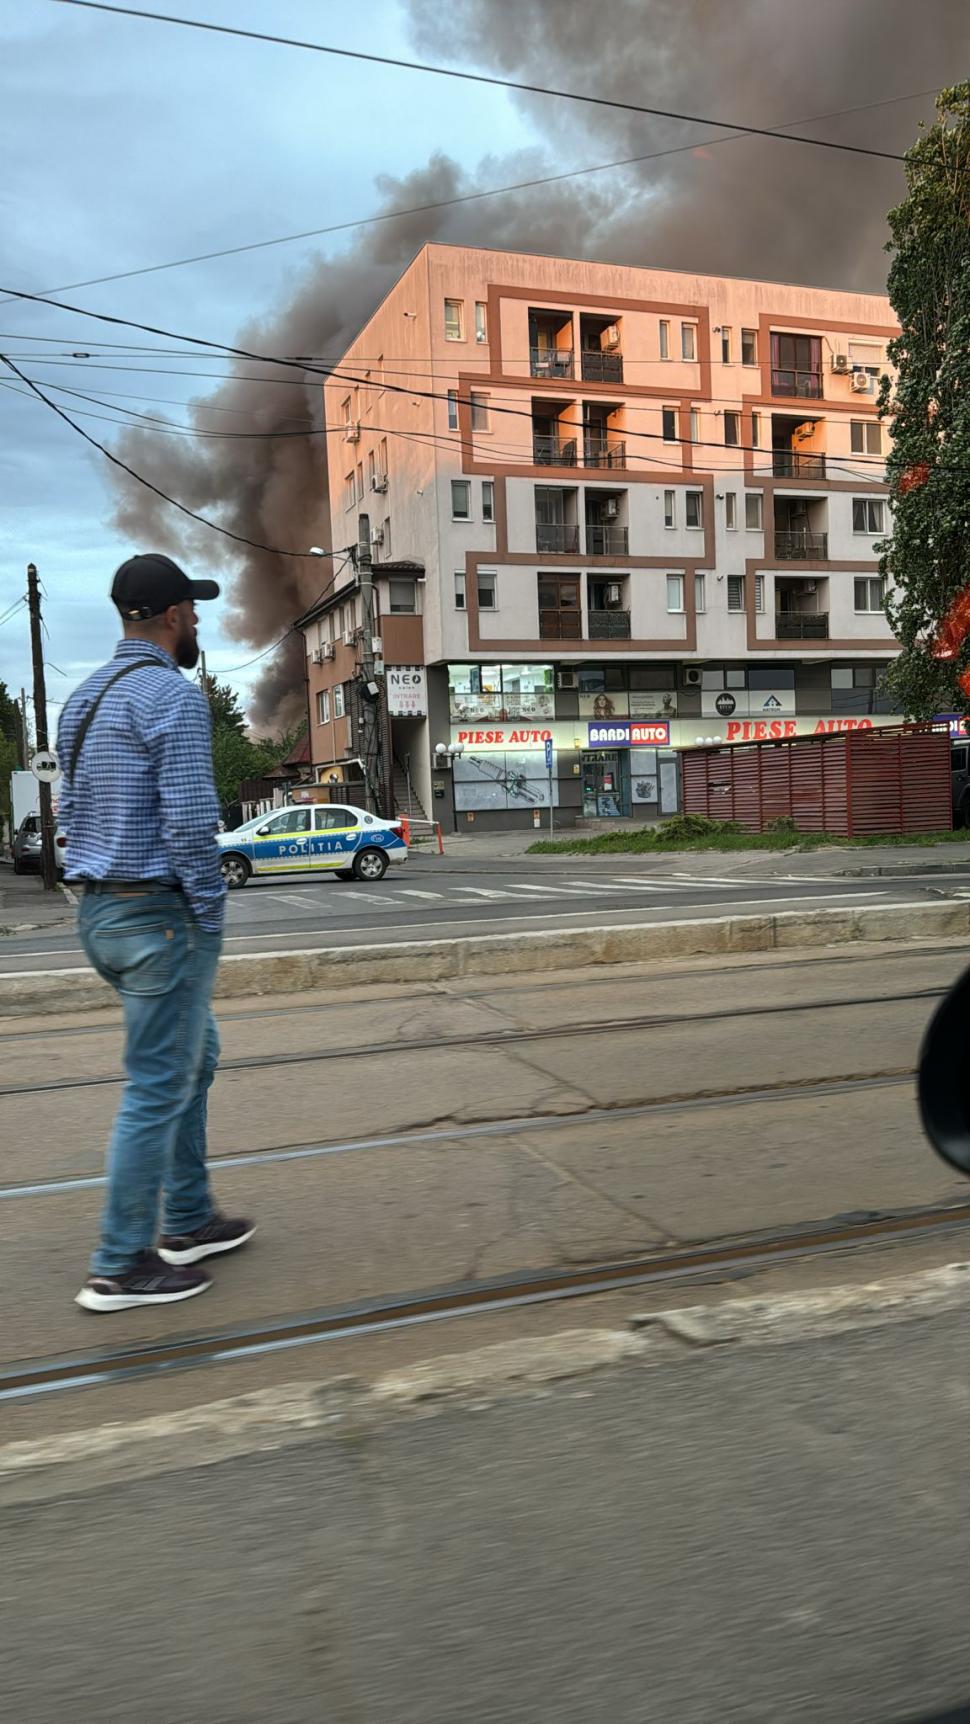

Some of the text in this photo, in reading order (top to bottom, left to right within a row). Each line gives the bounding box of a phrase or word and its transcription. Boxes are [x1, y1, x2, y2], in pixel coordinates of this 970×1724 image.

[390, 674, 421, 685] NEO
[458, 730, 552, 744] PIESE AUTO
[590, 727, 667, 742] BARDI AUTO
[726, 718, 874, 741] PIESE AUTO
[278, 841, 343, 856] POLITIA
